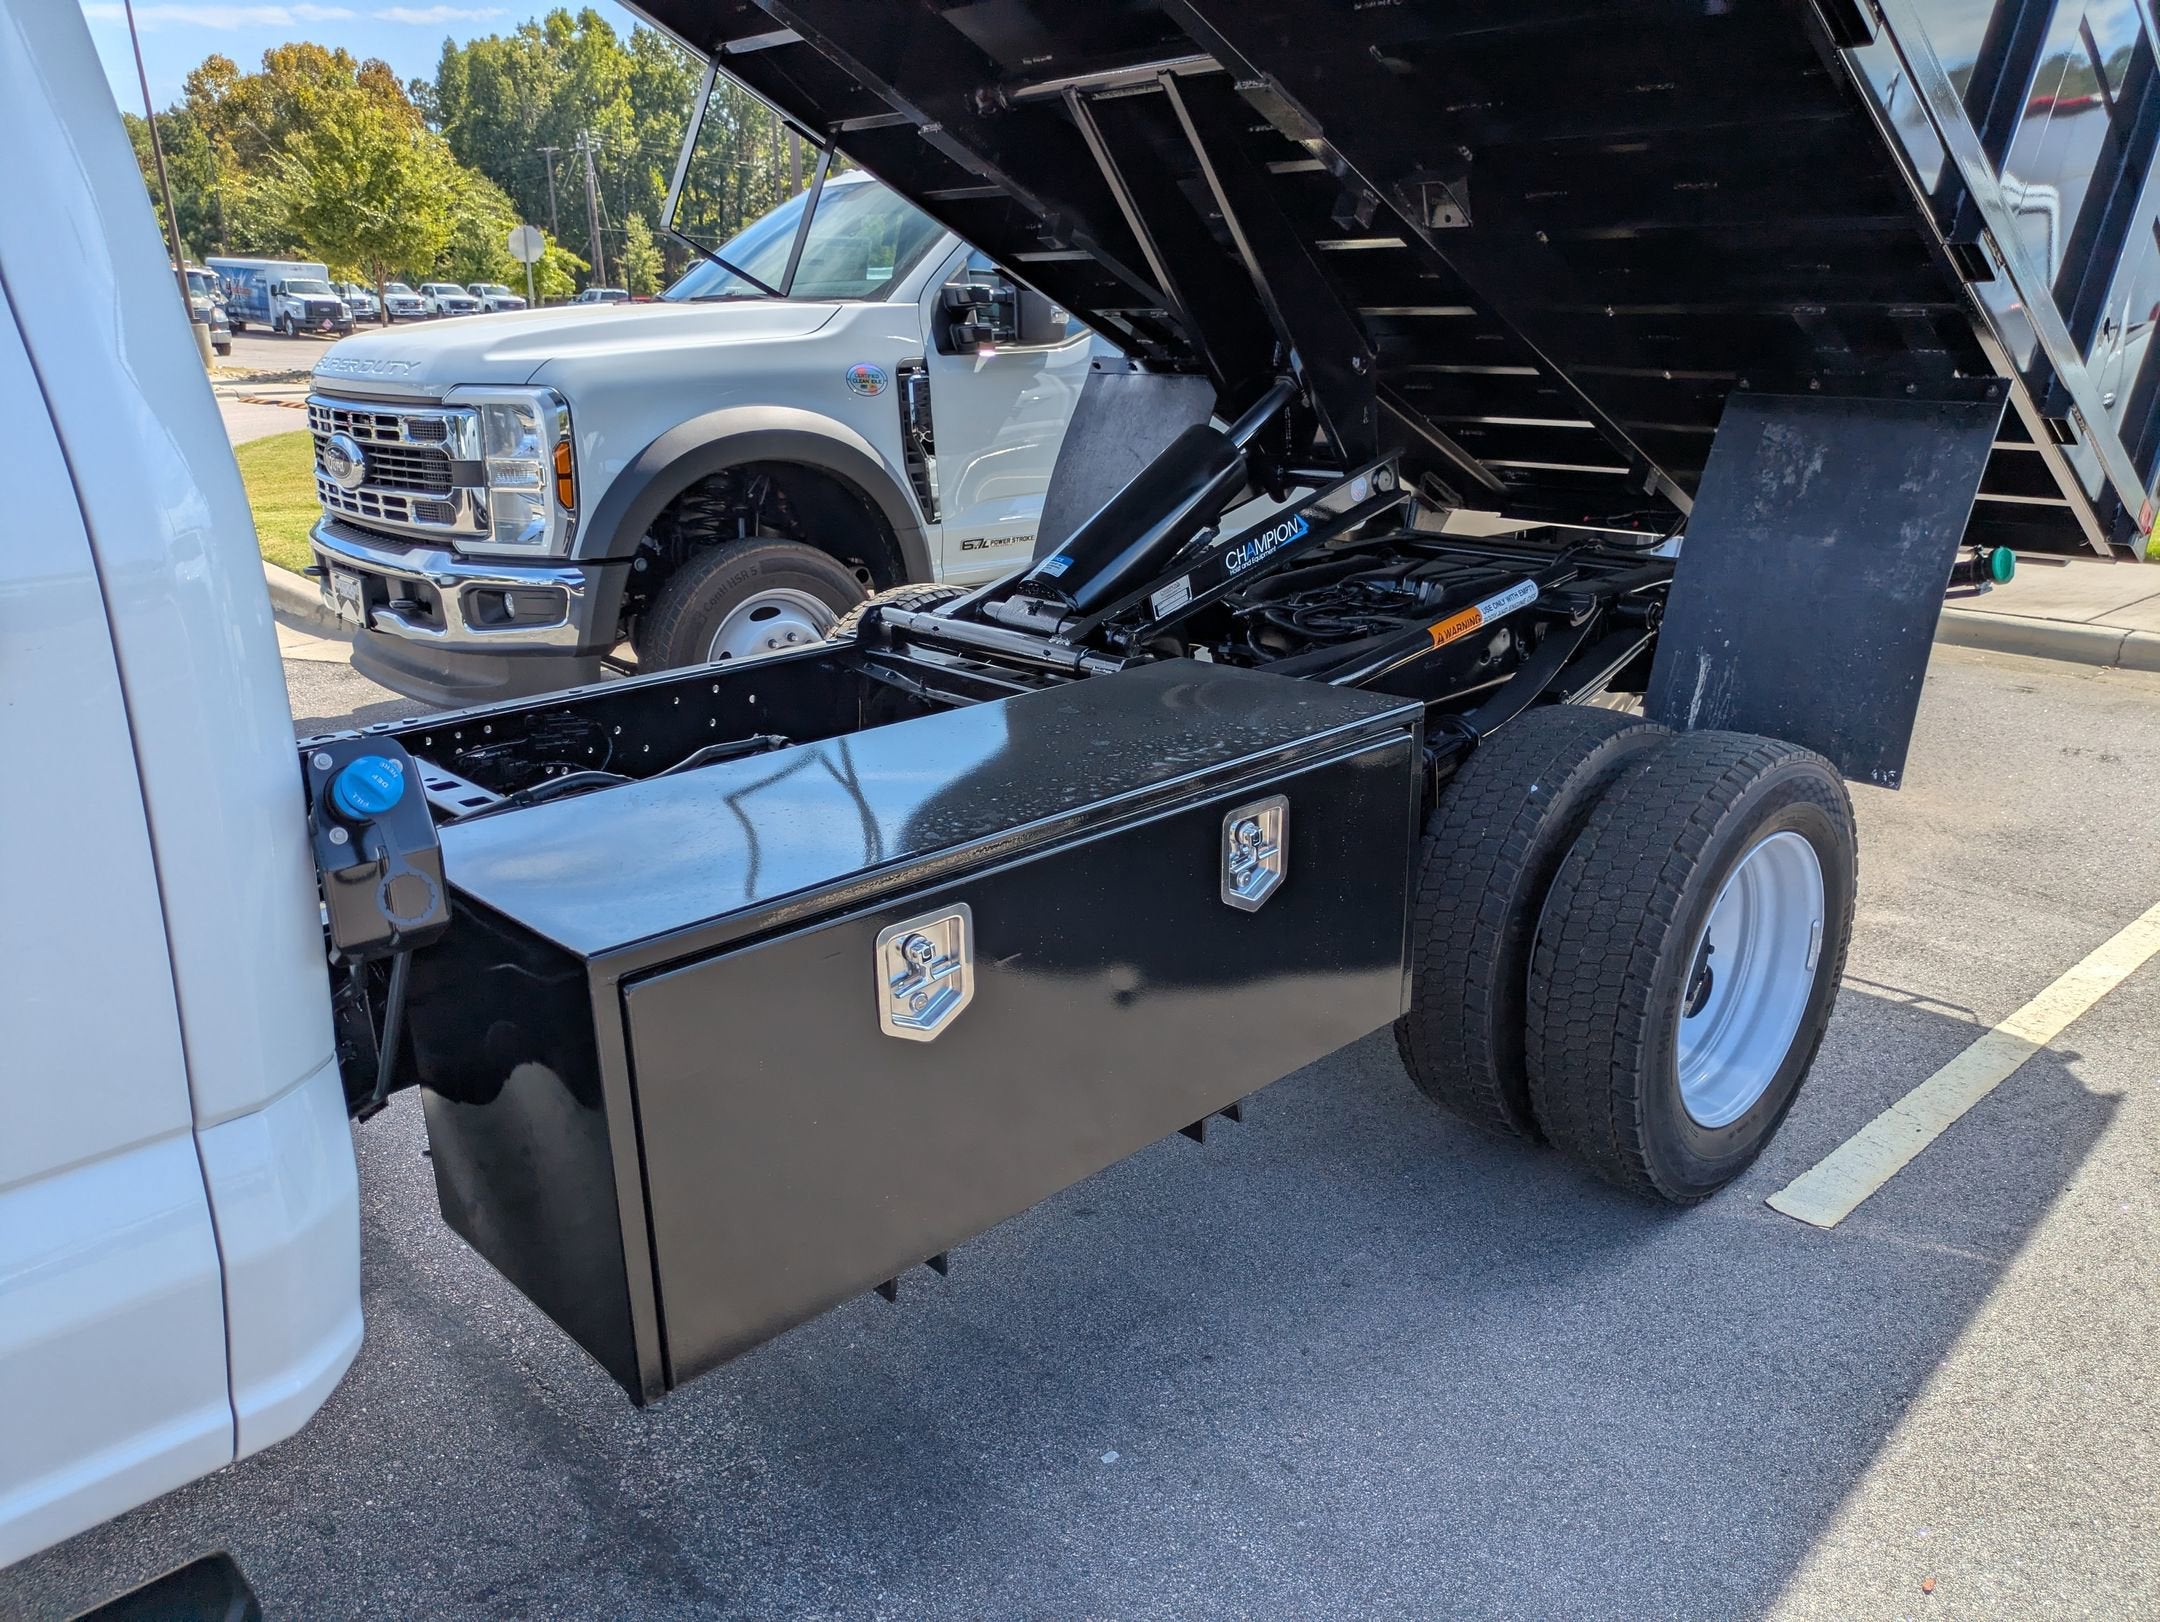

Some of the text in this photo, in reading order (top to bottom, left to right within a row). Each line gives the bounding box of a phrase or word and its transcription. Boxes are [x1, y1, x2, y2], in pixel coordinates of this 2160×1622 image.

[358, 359, 421, 376] DUTY
[961, 534, 1035, 551] 6.7L POWER STROKE
[1225, 517, 1298, 570] CHAMPION
[1241, 558, 1252, 570] and
[1251, 545, 1277, 564] Equipment
[1481, 583, 1536, 615] USE ONLY WITH EMPTY
[1443, 613, 1482, 640] WARNING
